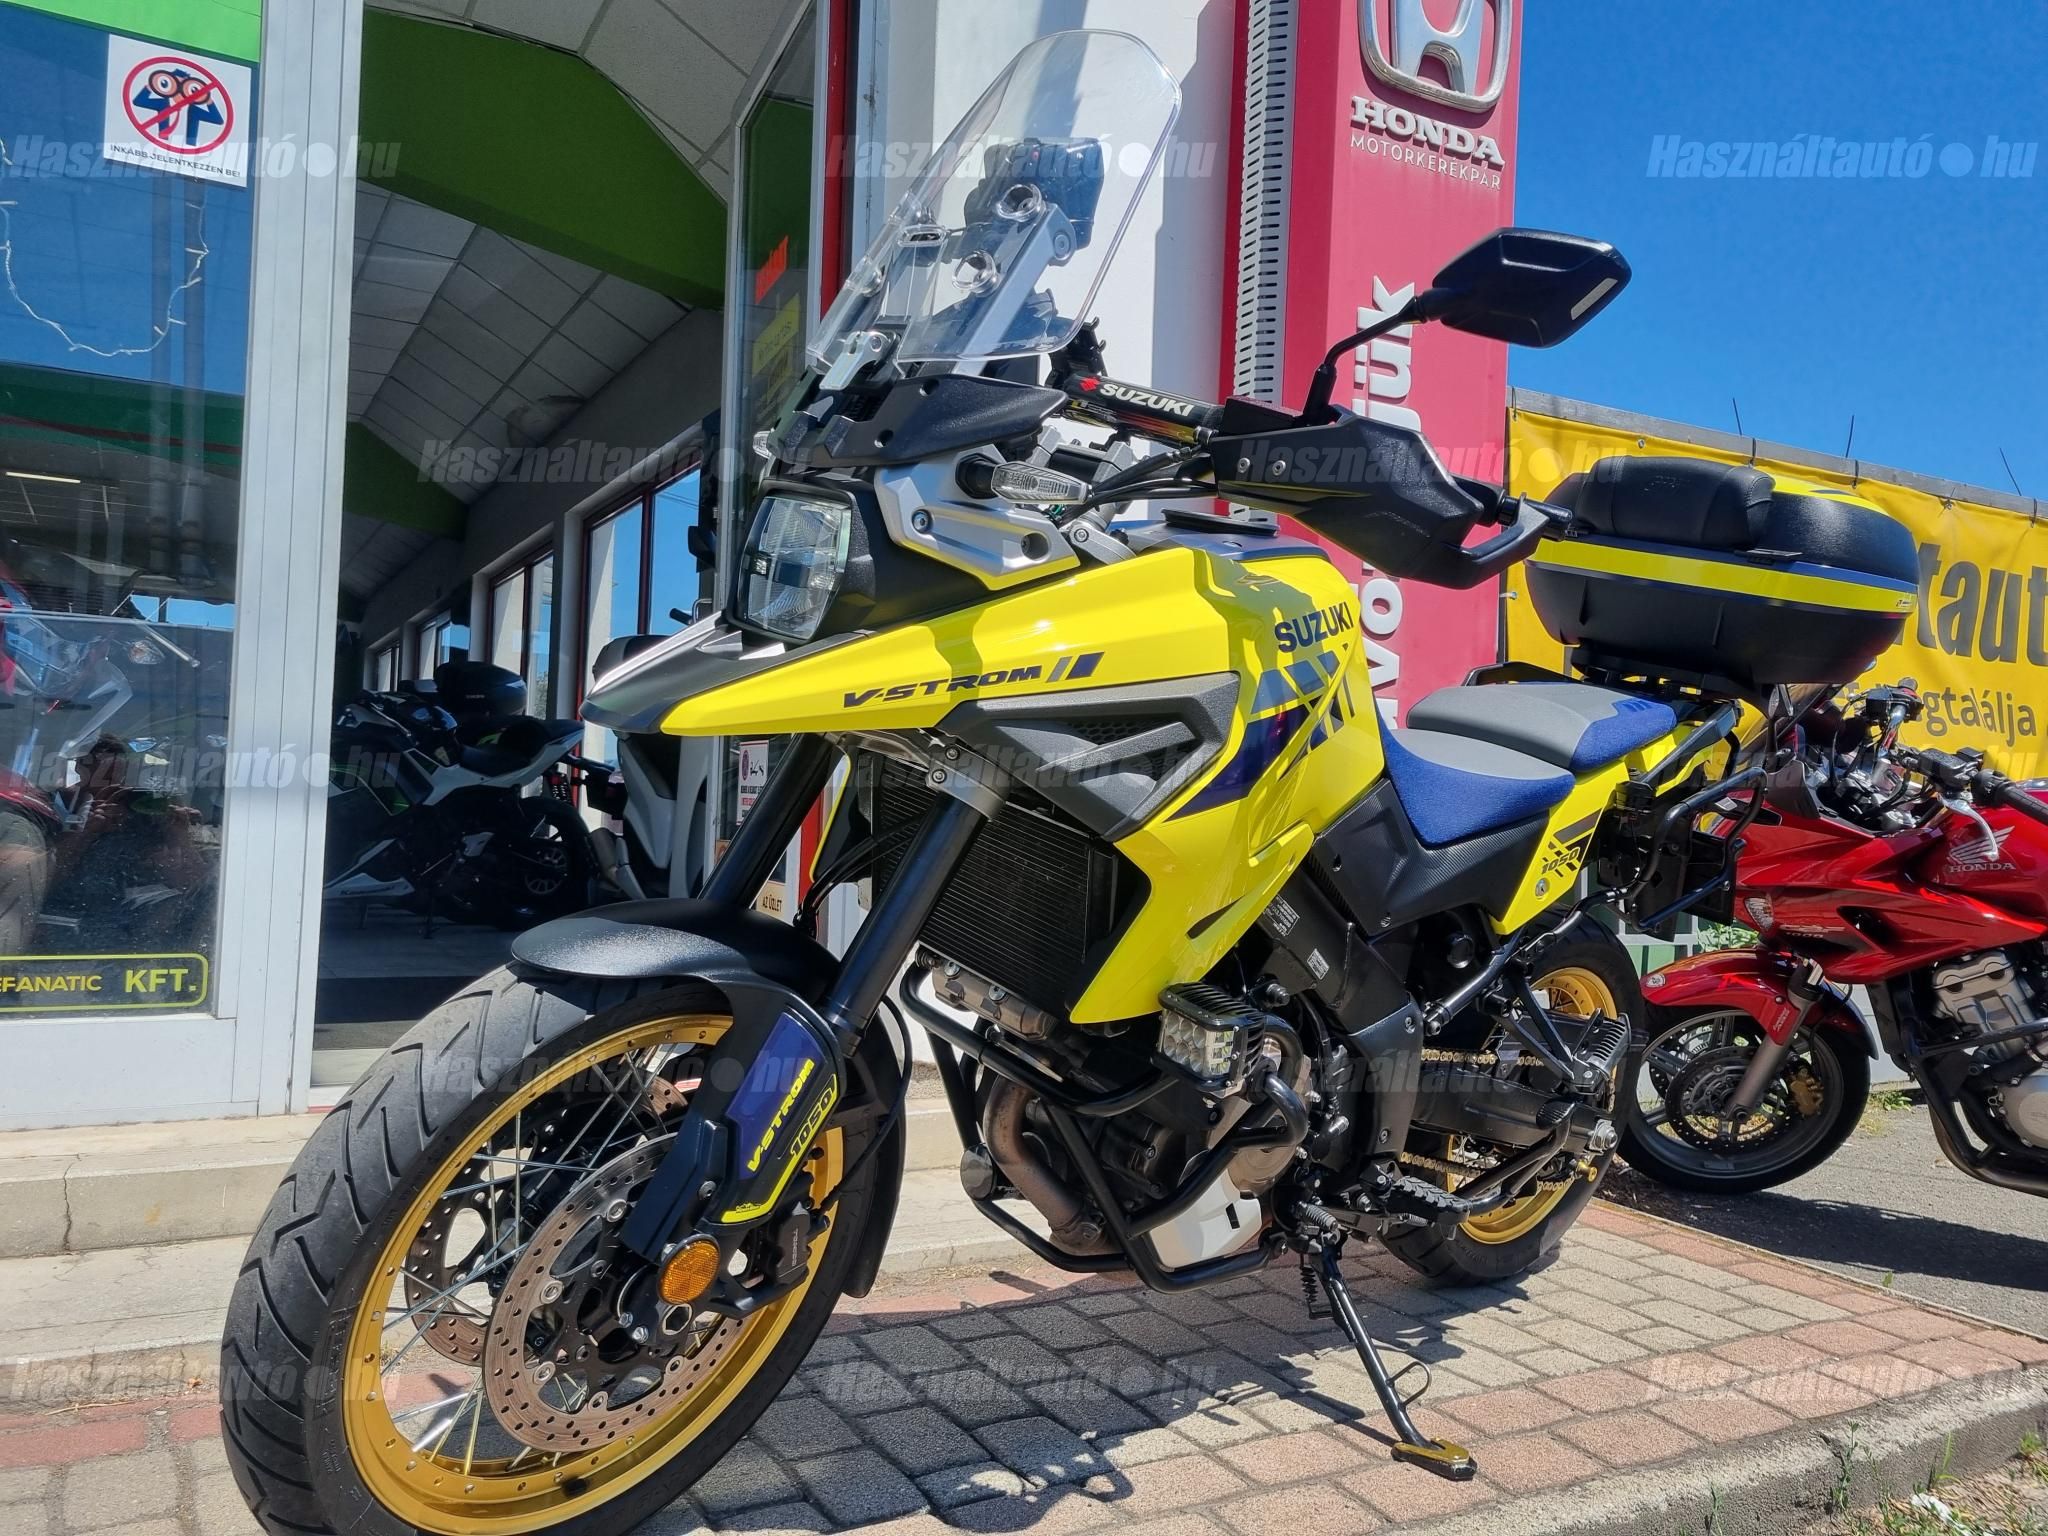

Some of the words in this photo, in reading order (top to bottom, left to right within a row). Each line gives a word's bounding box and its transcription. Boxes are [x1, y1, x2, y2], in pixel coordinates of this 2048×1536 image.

[1351, 96, 1505, 166] HONDA
[110, 144, 149, 158] INKÁBB
[149, 153, 224, 175] JELENTKEZZEN
[225, 169, 241, 177] BE!
[1350, 134, 1501, 190] MOTORKERÉKPÁR
[1100, 383, 1194, 417] SUZUKI
[1274, 602, 1354, 653] SUZUKI
[1893, 542, 2048, 666] taut
[843, 665, 1043, 708] V-STROM
[1541, 847, 1581, 874] 1050
[1949, 862, 2017, 873] HONDA
[125, 968, 197, 993] KFT.
[747, 1058, 815, 1172] V-STROM
[790, 1086, 834, 1157] 1050
